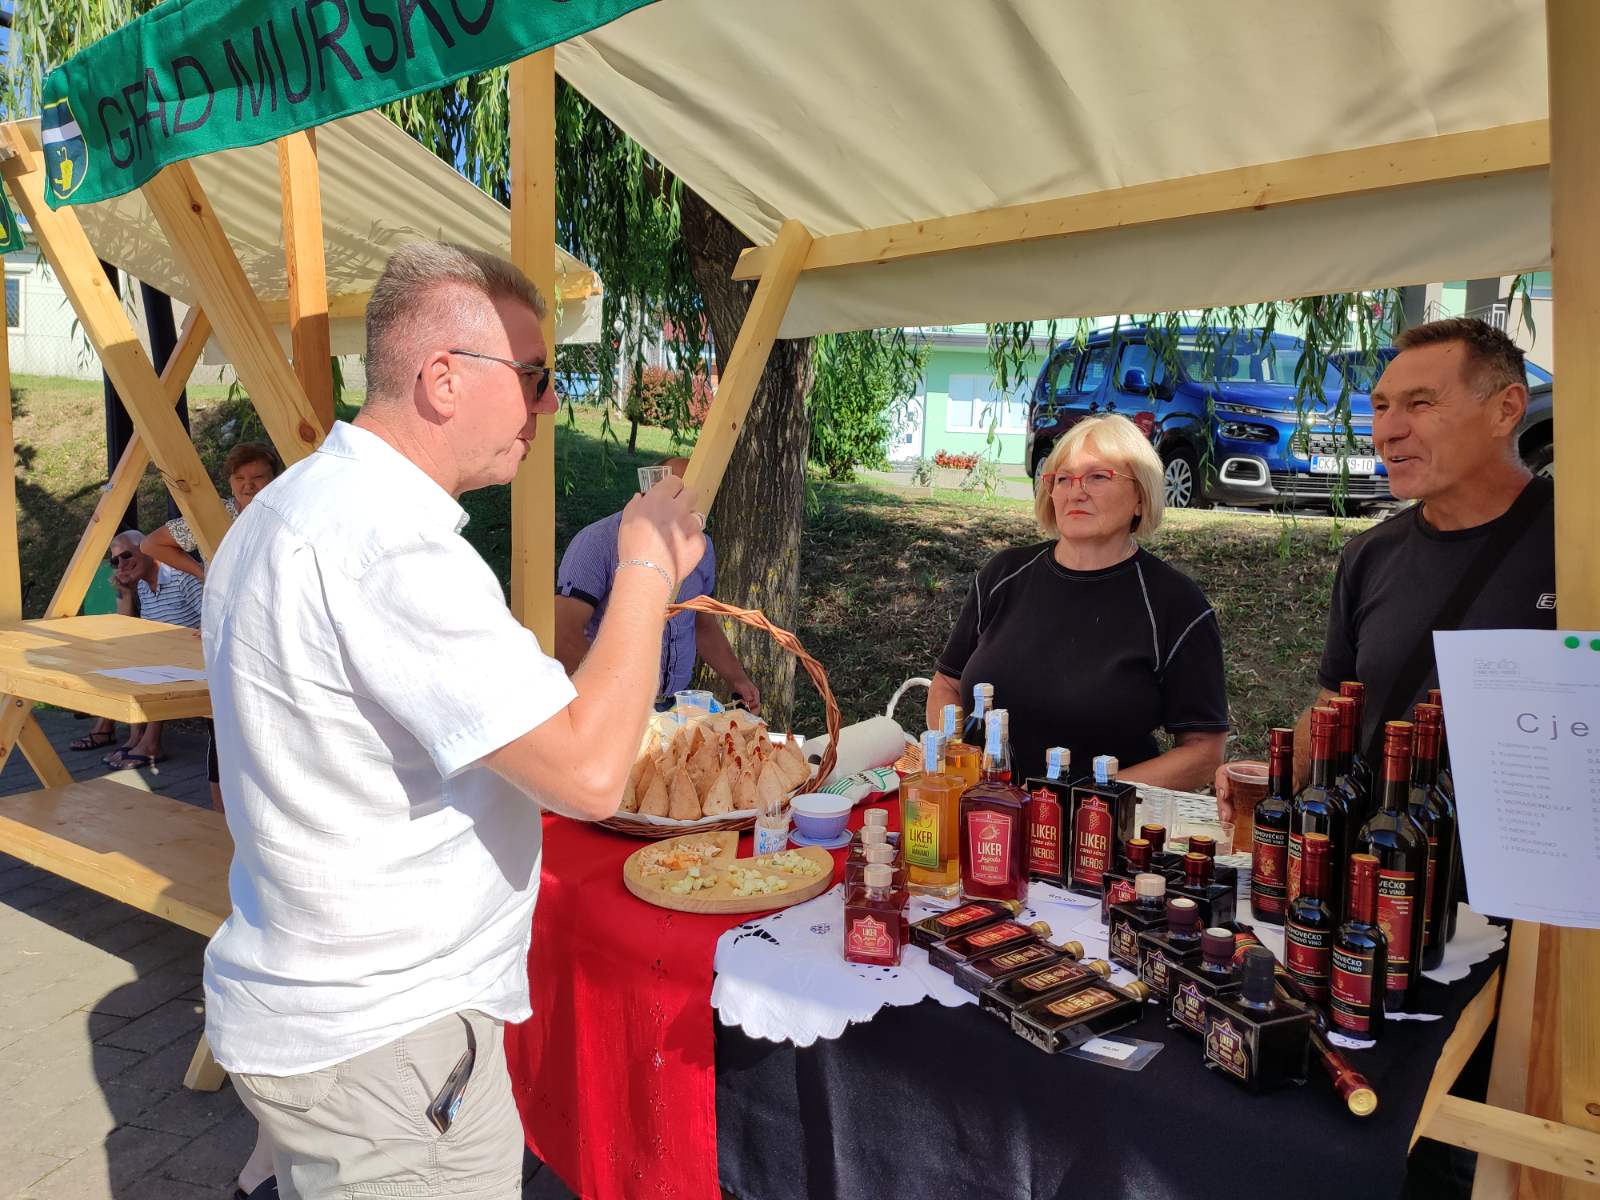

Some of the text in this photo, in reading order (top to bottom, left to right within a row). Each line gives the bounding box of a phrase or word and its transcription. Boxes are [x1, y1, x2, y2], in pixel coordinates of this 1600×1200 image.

[910, 828, 933, 844] LIKER
[1031, 823, 1058, 840] LIKER
[1080, 831, 1107, 850] LIKER
[977, 841, 1002, 857] LIKER
[1033, 846, 1056, 861] NEROS
[1080, 855, 1104, 870] NEROS
